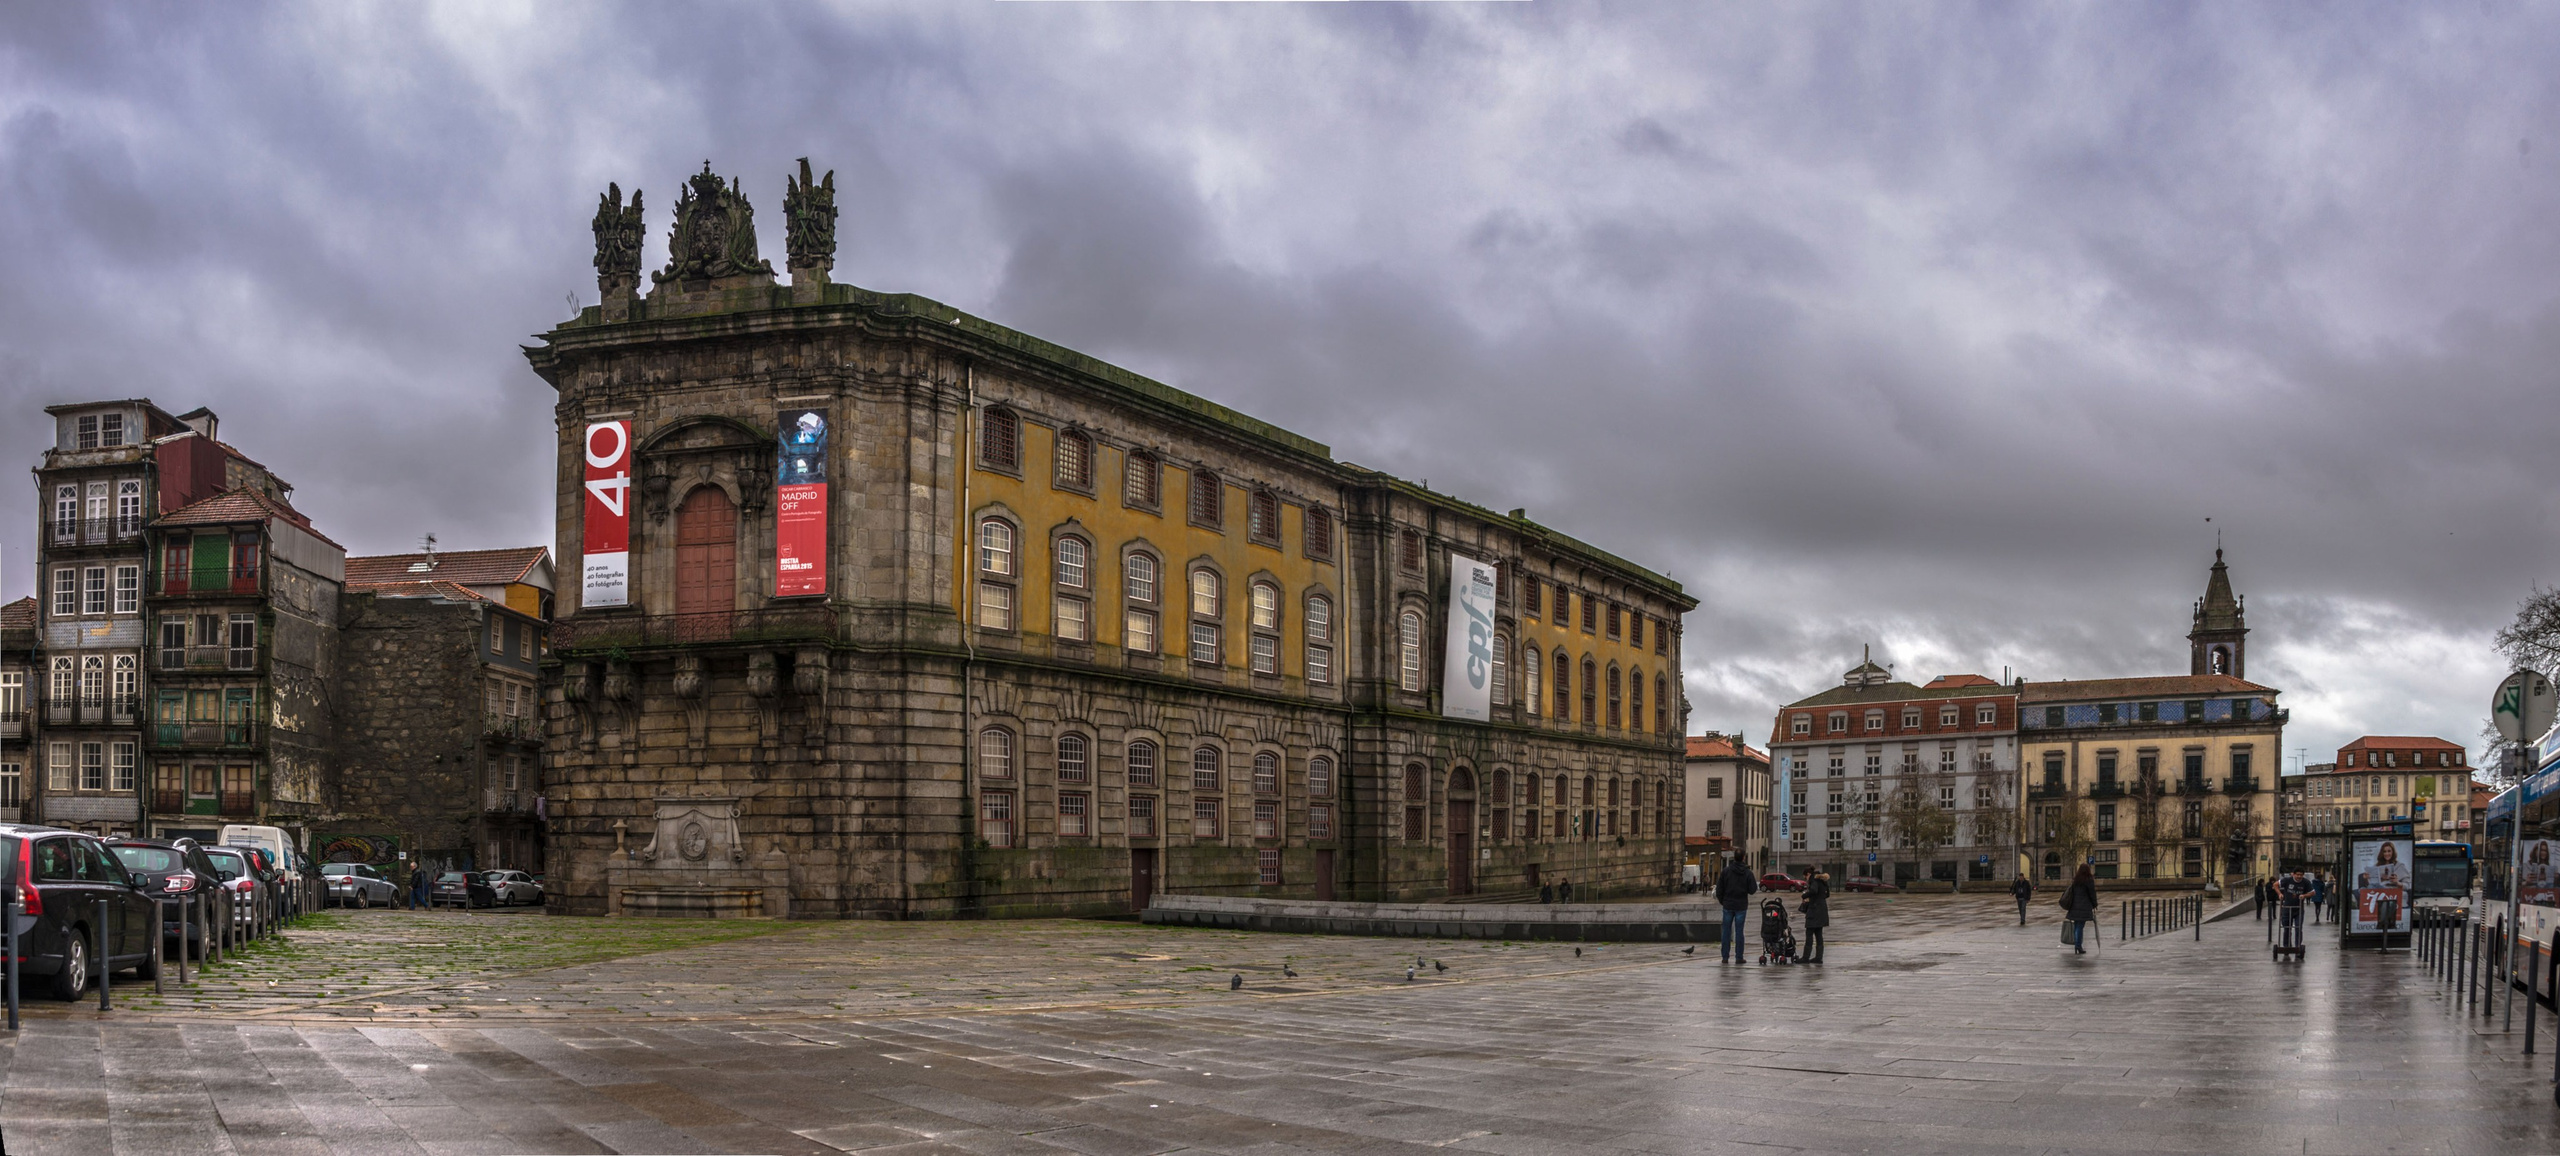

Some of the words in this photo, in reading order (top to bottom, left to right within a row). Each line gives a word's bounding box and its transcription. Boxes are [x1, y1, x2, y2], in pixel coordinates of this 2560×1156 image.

[585, 420, 630, 517] 40
[781, 491, 818, 501] MADRID
[781, 502, 799, 511] OFF
[595, 571, 624, 579] fotografias
[595, 580, 623, 588] fotógrafos
